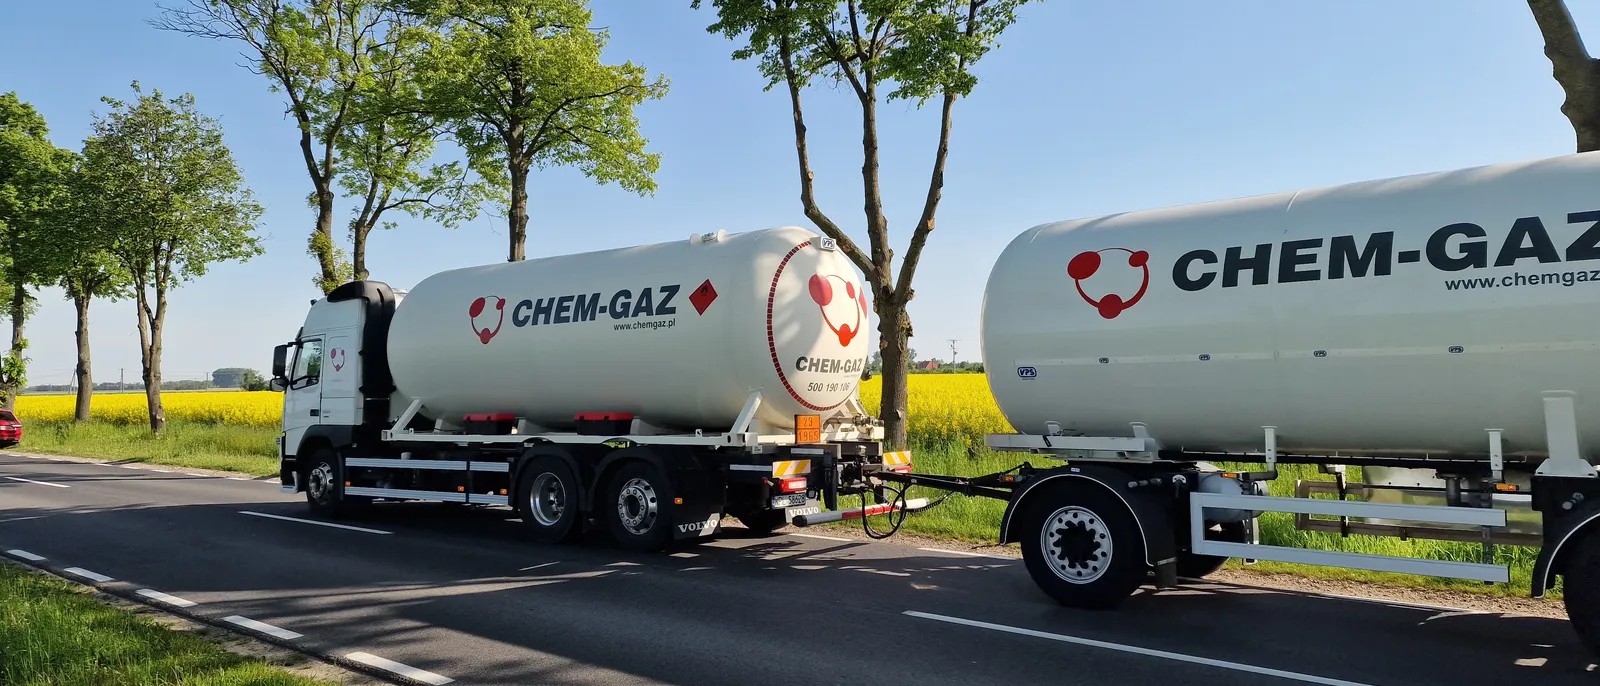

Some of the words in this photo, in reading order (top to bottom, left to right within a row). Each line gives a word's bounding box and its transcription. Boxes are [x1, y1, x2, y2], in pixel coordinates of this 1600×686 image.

[1172, 210, 1600, 291] CHEM-GAZ
[512, 284, 681, 328] CHEM-GAZ
[613, 317, 676, 331] www.chemgaz.pl
[795, 356, 863, 373] CHEM-GAZ
[1019, 368, 1036, 376] VPS
[807, 382, 823, 392] 500
[825, 383, 838, 392] 190
[803, 416, 813, 427] 23
[798, 430, 818, 441] 1965
[789, 507, 819, 517] VOLVO
[678, 519, 717, 533] VOLVO
